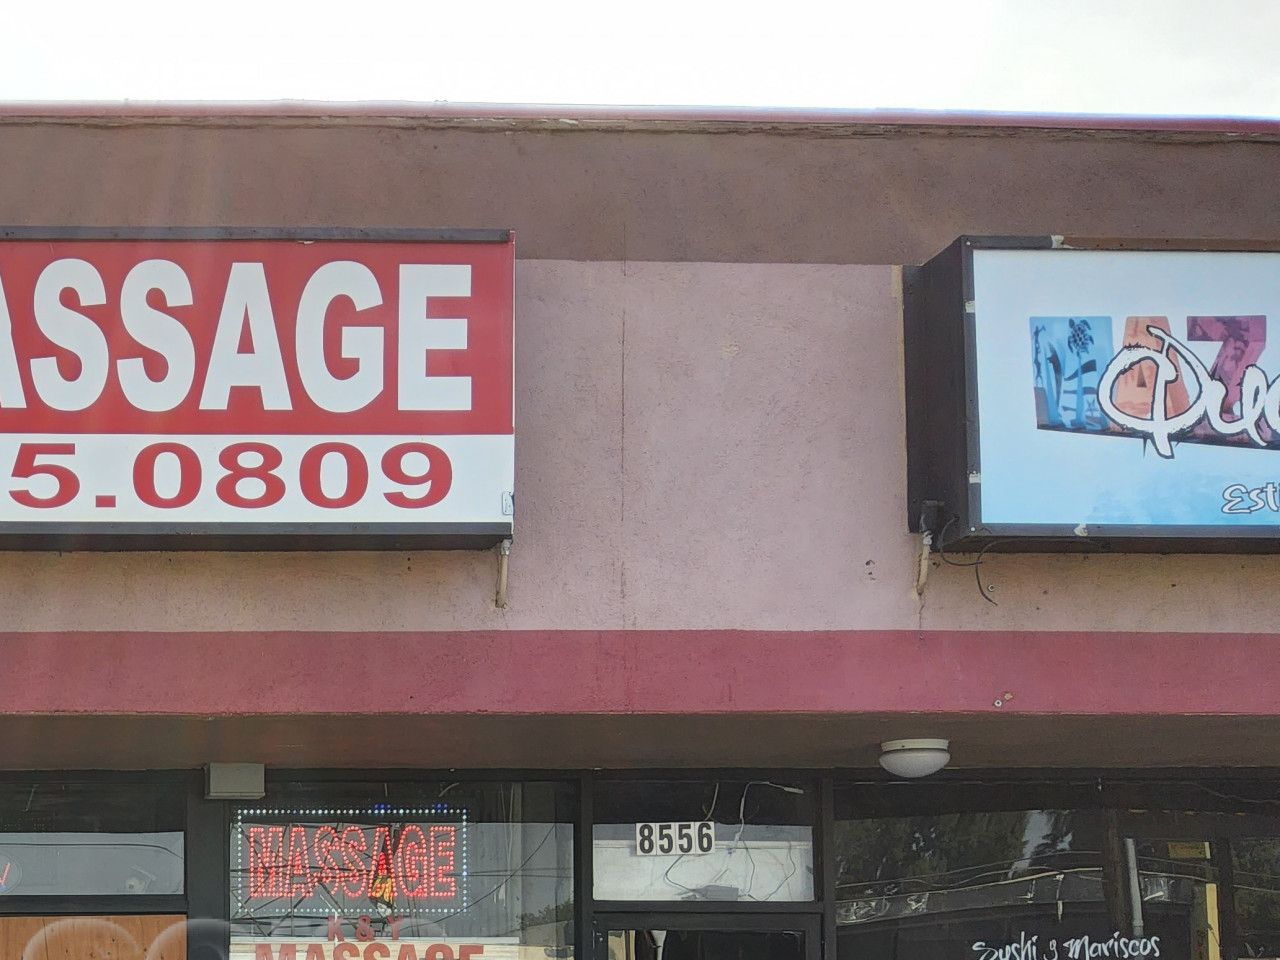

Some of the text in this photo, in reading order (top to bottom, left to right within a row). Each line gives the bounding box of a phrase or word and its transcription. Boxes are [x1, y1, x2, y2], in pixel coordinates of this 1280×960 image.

[639, 823, 713, 854] 8556
[248, 825, 456, 898] MASSAGE
[327, 916, 344, 942] K
[355, 915, 375, 942] &
